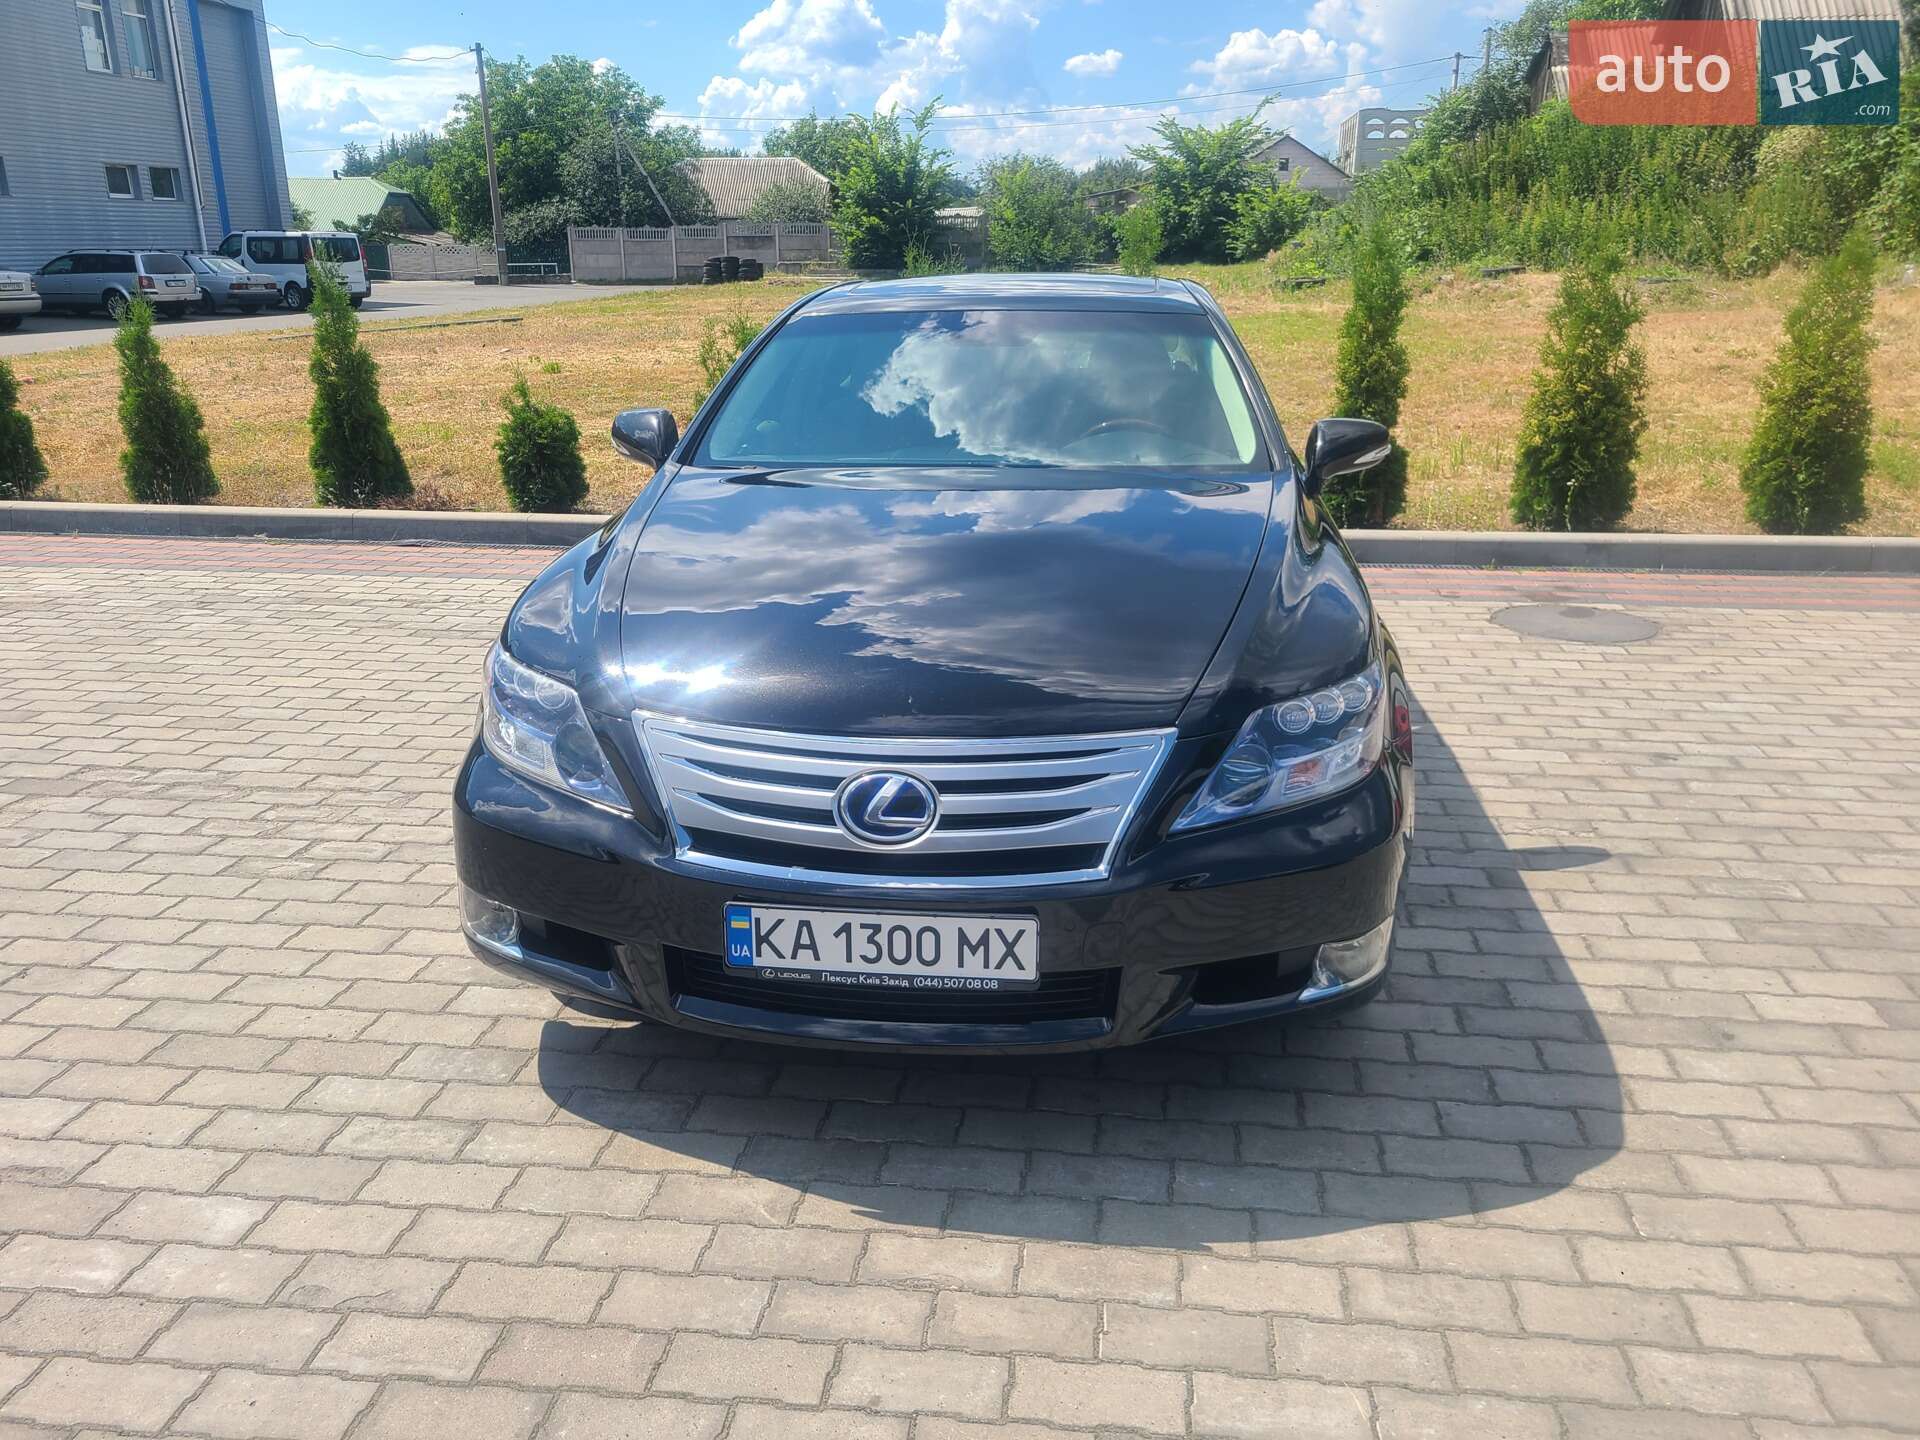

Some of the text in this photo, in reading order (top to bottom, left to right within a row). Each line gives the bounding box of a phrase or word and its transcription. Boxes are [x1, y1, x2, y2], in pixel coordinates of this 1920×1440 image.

[731, 943, 751, 958] UA
[754, 917, 1026, 971] KA 1300 MX
[777, 971, 811, 979] LEXUS
[859, 974, 880, 985] Київ
[881, 975, 909, 988] Захід
[913, 977, 943, 989] (044)
[944, 978, 965, 988] 507
[966, 979, 982, 989] 08
[983, 979, 999, 989] 08
